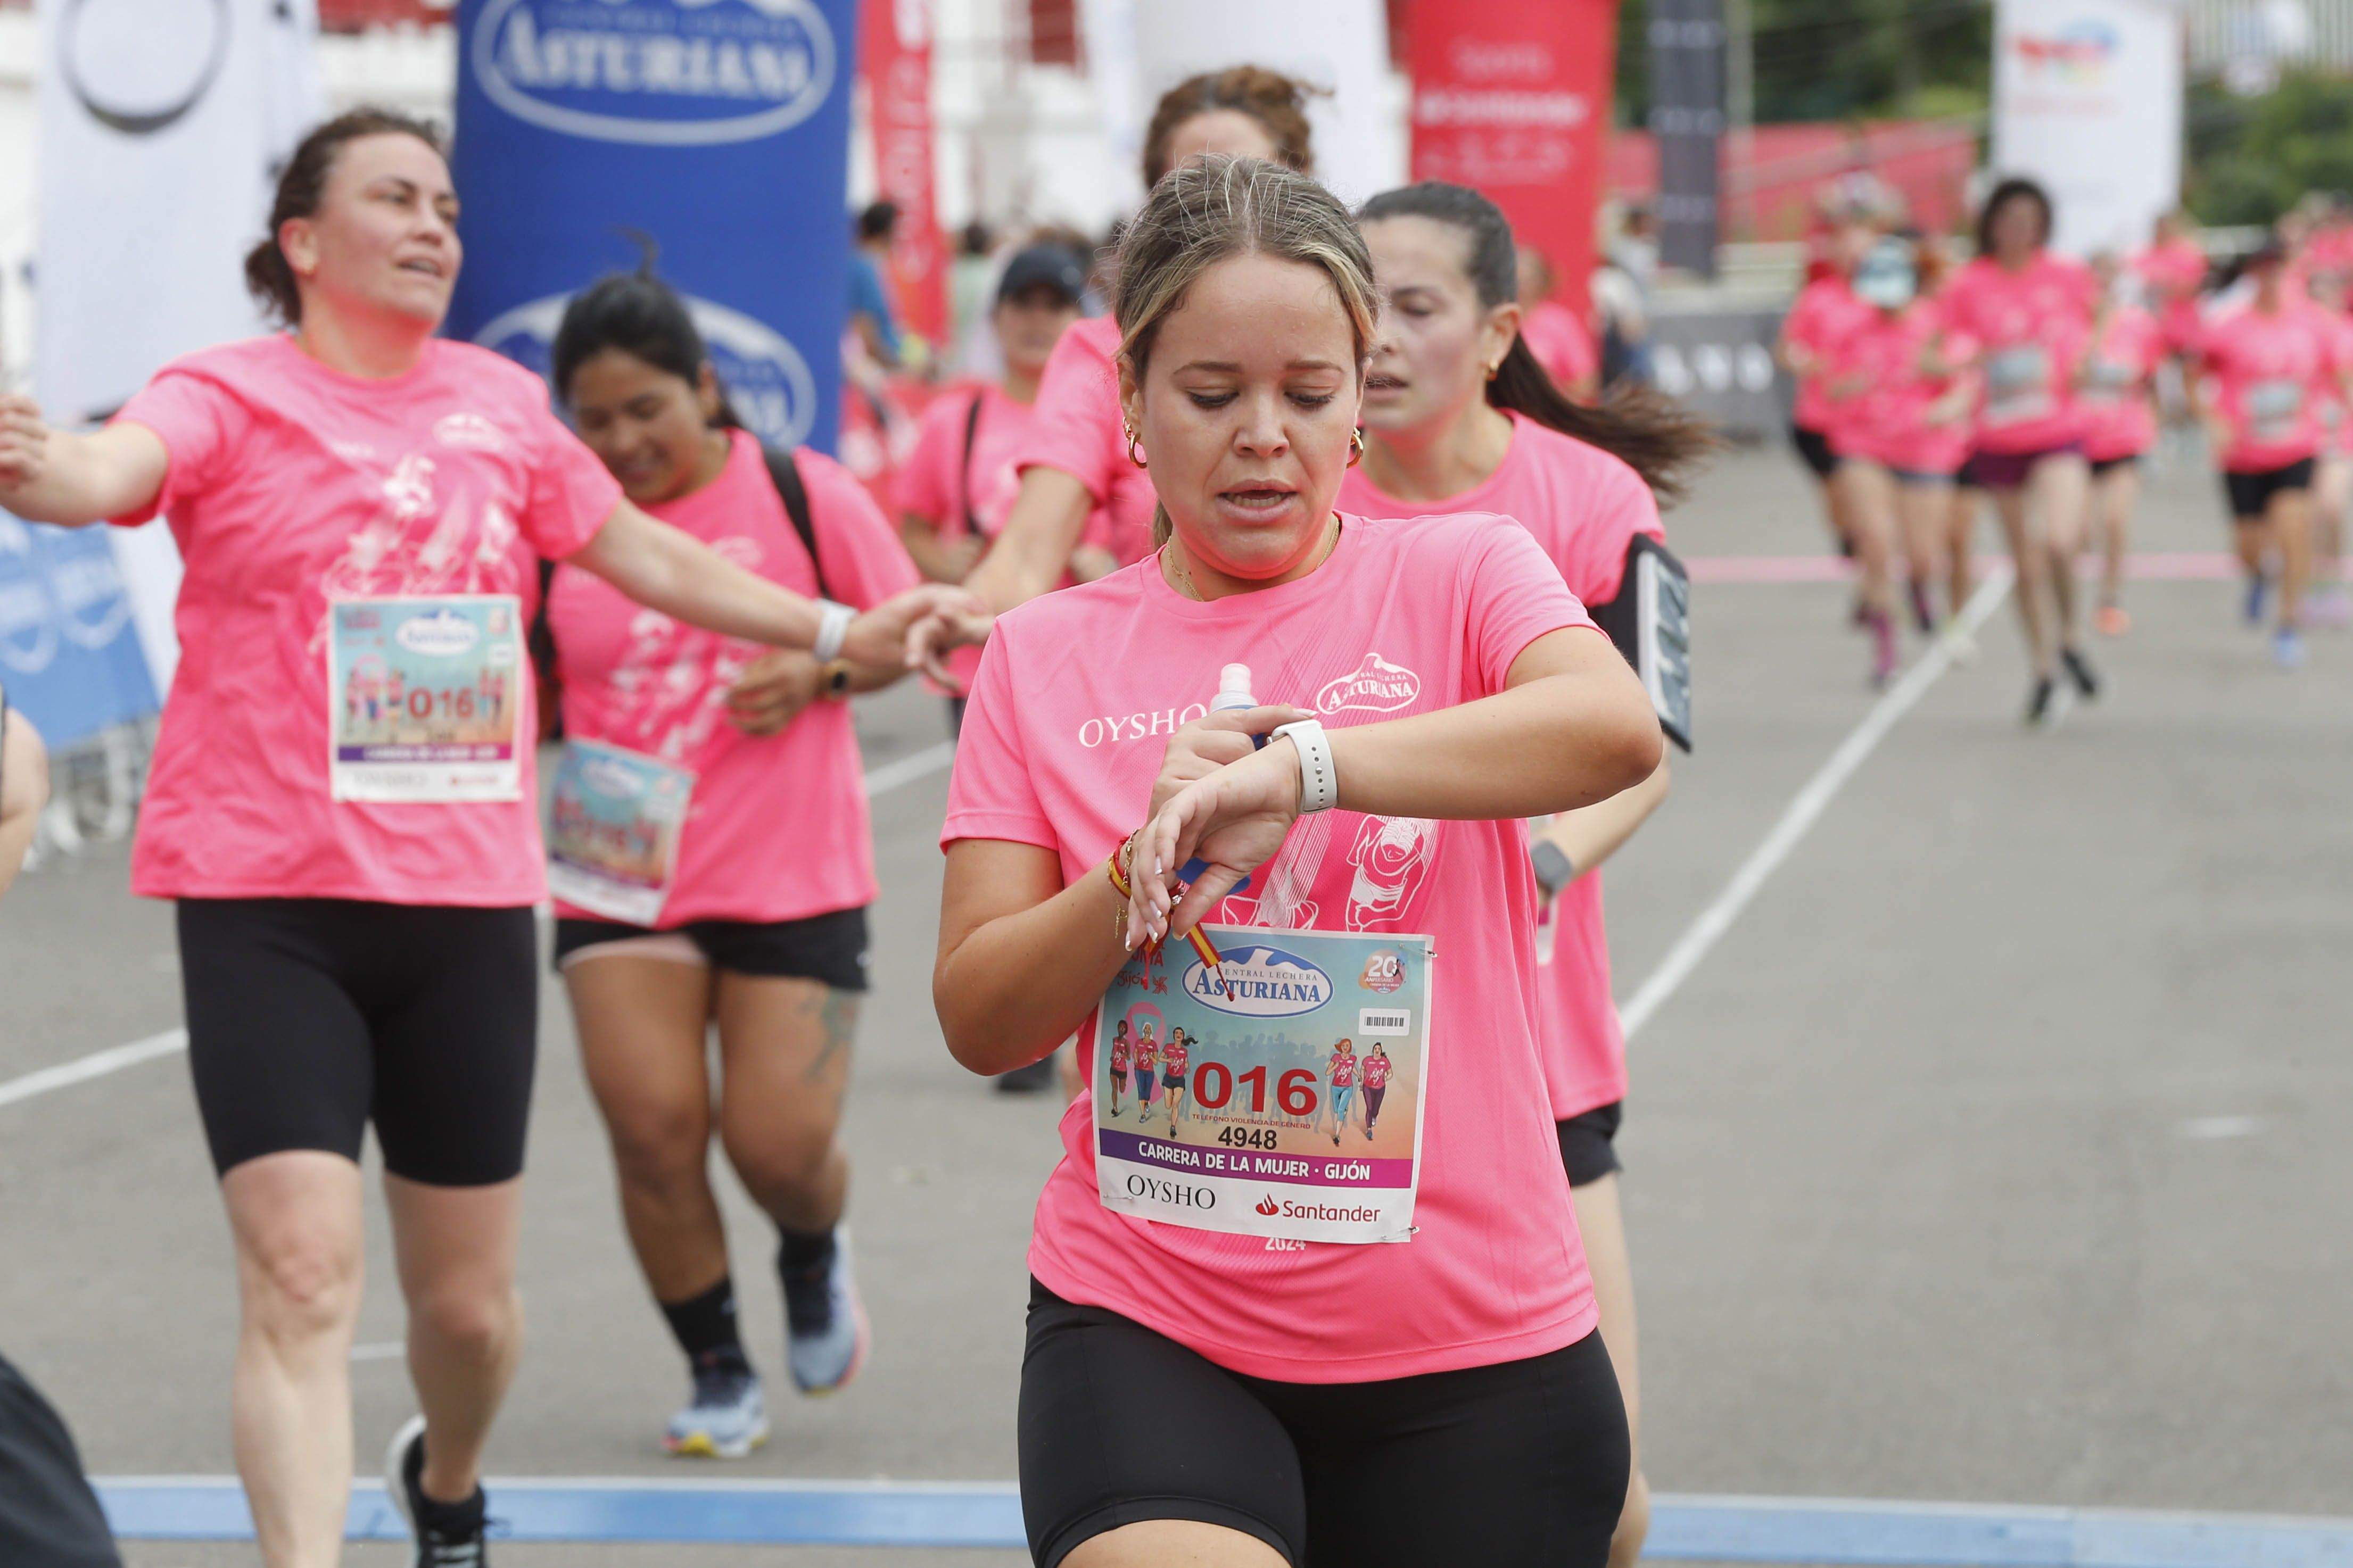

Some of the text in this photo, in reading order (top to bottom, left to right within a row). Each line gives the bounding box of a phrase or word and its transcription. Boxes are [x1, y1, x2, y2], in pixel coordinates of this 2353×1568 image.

[408, 687, 476, 719] 016
[1192, 968, 1322, 1002] ASTURIANA
[1220, 967, 1318, 981] ENTRAL LECHERA
[1193, 1061, 1317, 1116] 016
[1230, 1117, 1269, 1126] VIOLENCIA
[1218, 1126, 1277, 1150] 4948
[1138, 1141, 1370, 1180] CARRERA DE LA MUJER GIJÓN
[1127, 1174, 1216, 1210] OYSHO
[1282, 1200, 1381, 1222] Santander
[1265, 1237, 1306, 1251] 2024
